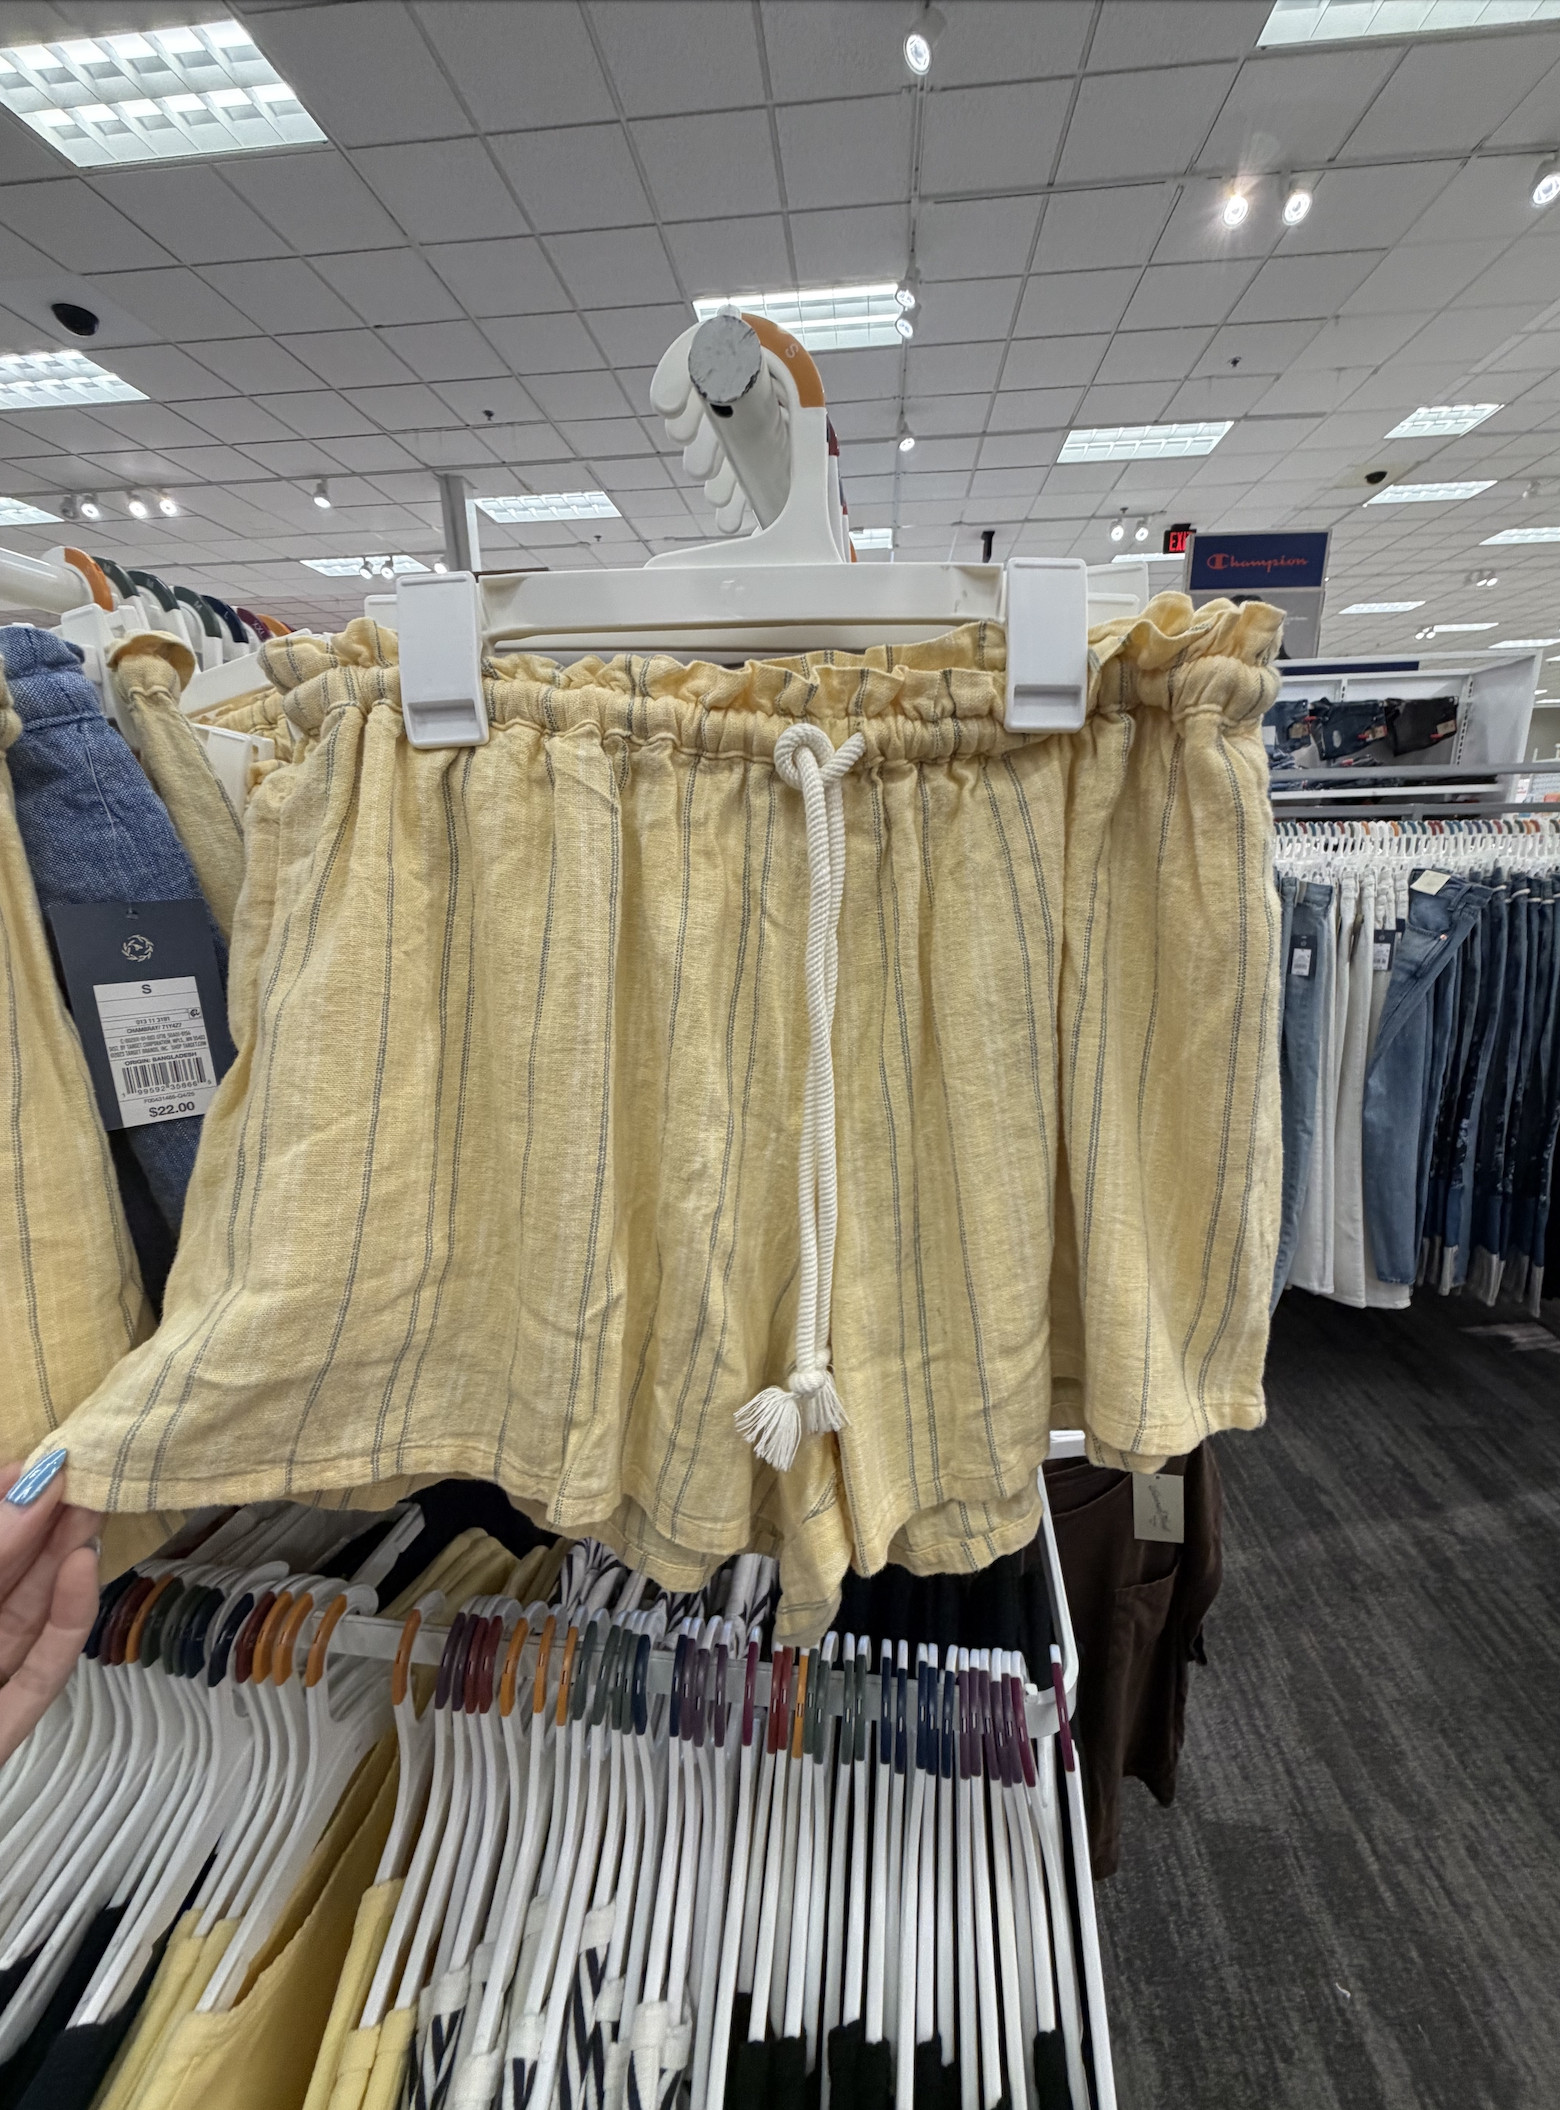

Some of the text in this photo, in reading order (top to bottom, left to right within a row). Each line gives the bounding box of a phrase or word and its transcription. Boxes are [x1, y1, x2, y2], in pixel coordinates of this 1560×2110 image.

[785, 343, 800, 358] S
[1206, 553, 1309, 573] Champion
[141, 984, 152, 994] S
[124, 1051, 197, 1066] ORIGIN: BANGLADESH
[148, 1101, 195, 1118] $22.00
